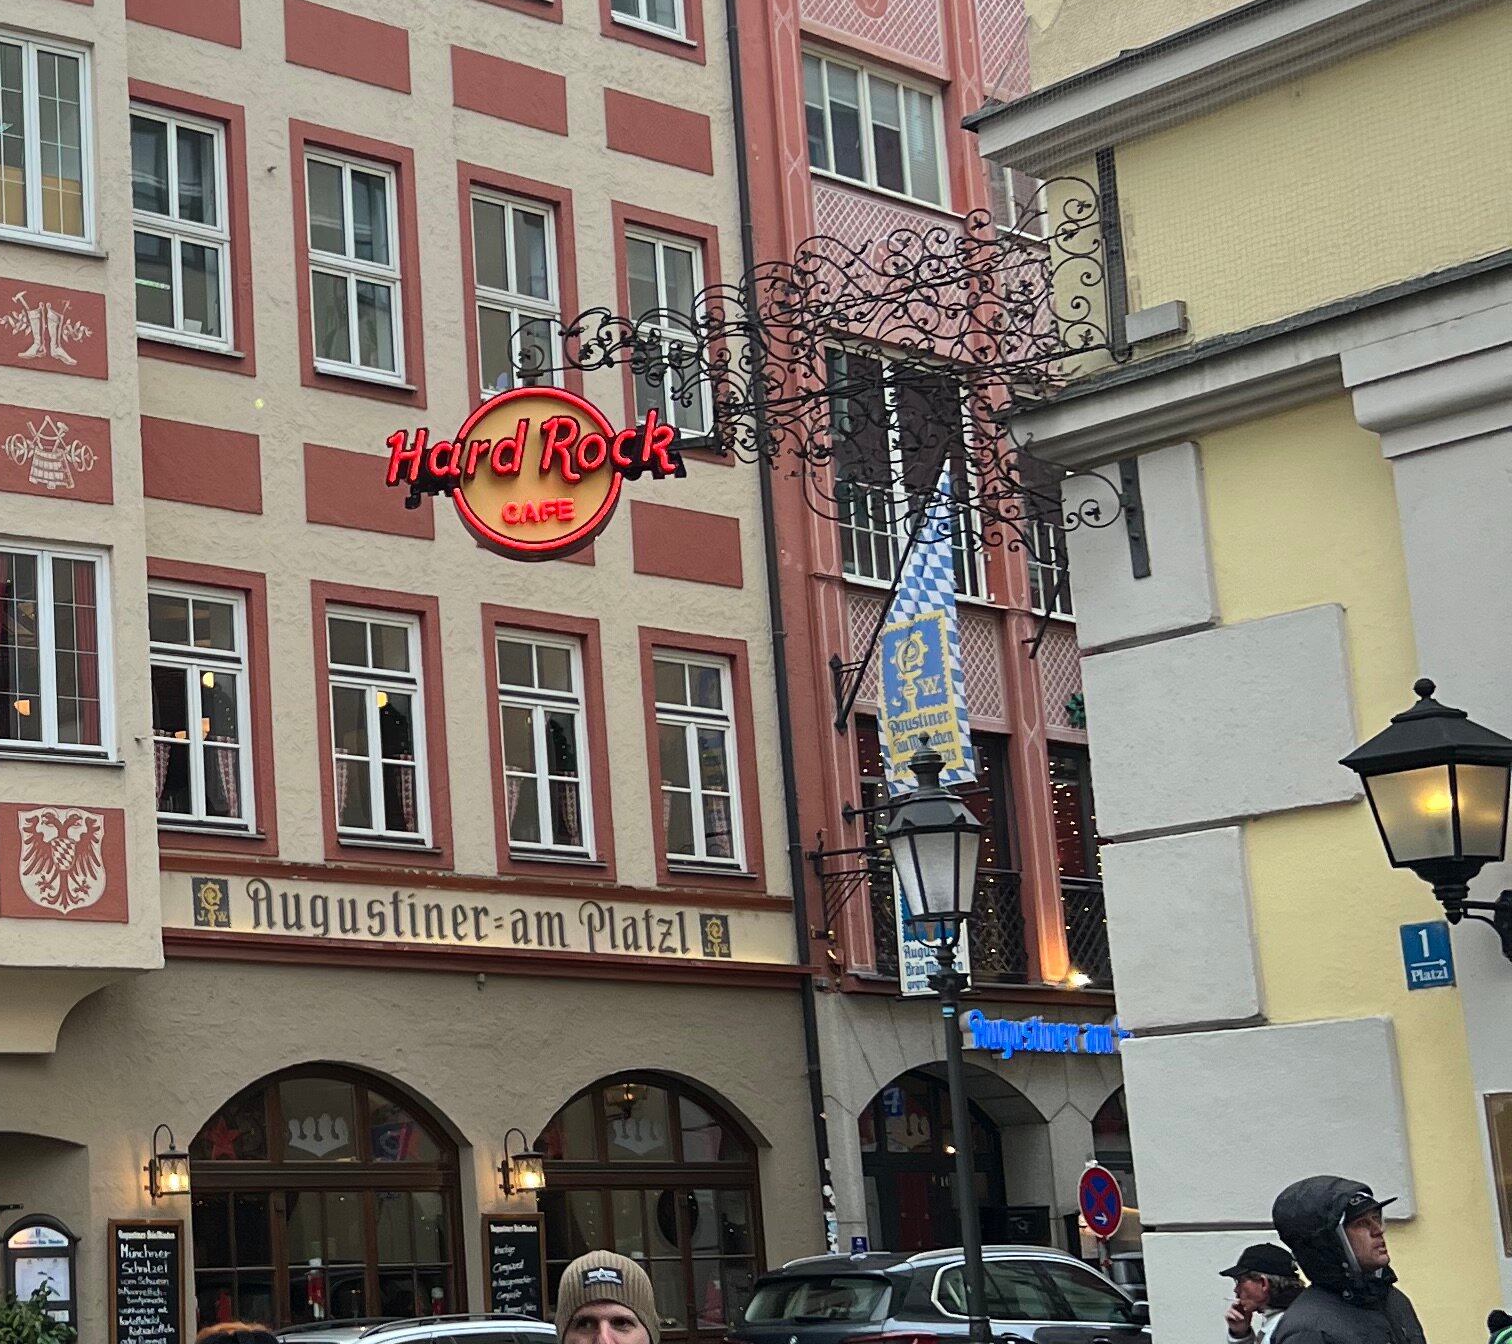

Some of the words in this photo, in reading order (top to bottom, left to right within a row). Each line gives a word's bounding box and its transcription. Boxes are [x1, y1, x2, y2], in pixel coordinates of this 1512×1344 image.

[386, 418, 529, 487] Hard
[540, 408, 676, 484] Rock
[501, 498, 575, 525] CAFE
[579, 900, 691, 955] Platzl
[1418, 928, 1430, 958] 1
[1410, 966, 1449, 983] Platzl
[968, 1009, 1079, 1059] Augustiner
[1084, 1023, 1113, 1054] am
[120, 1243, 172, 1259] Münchner
